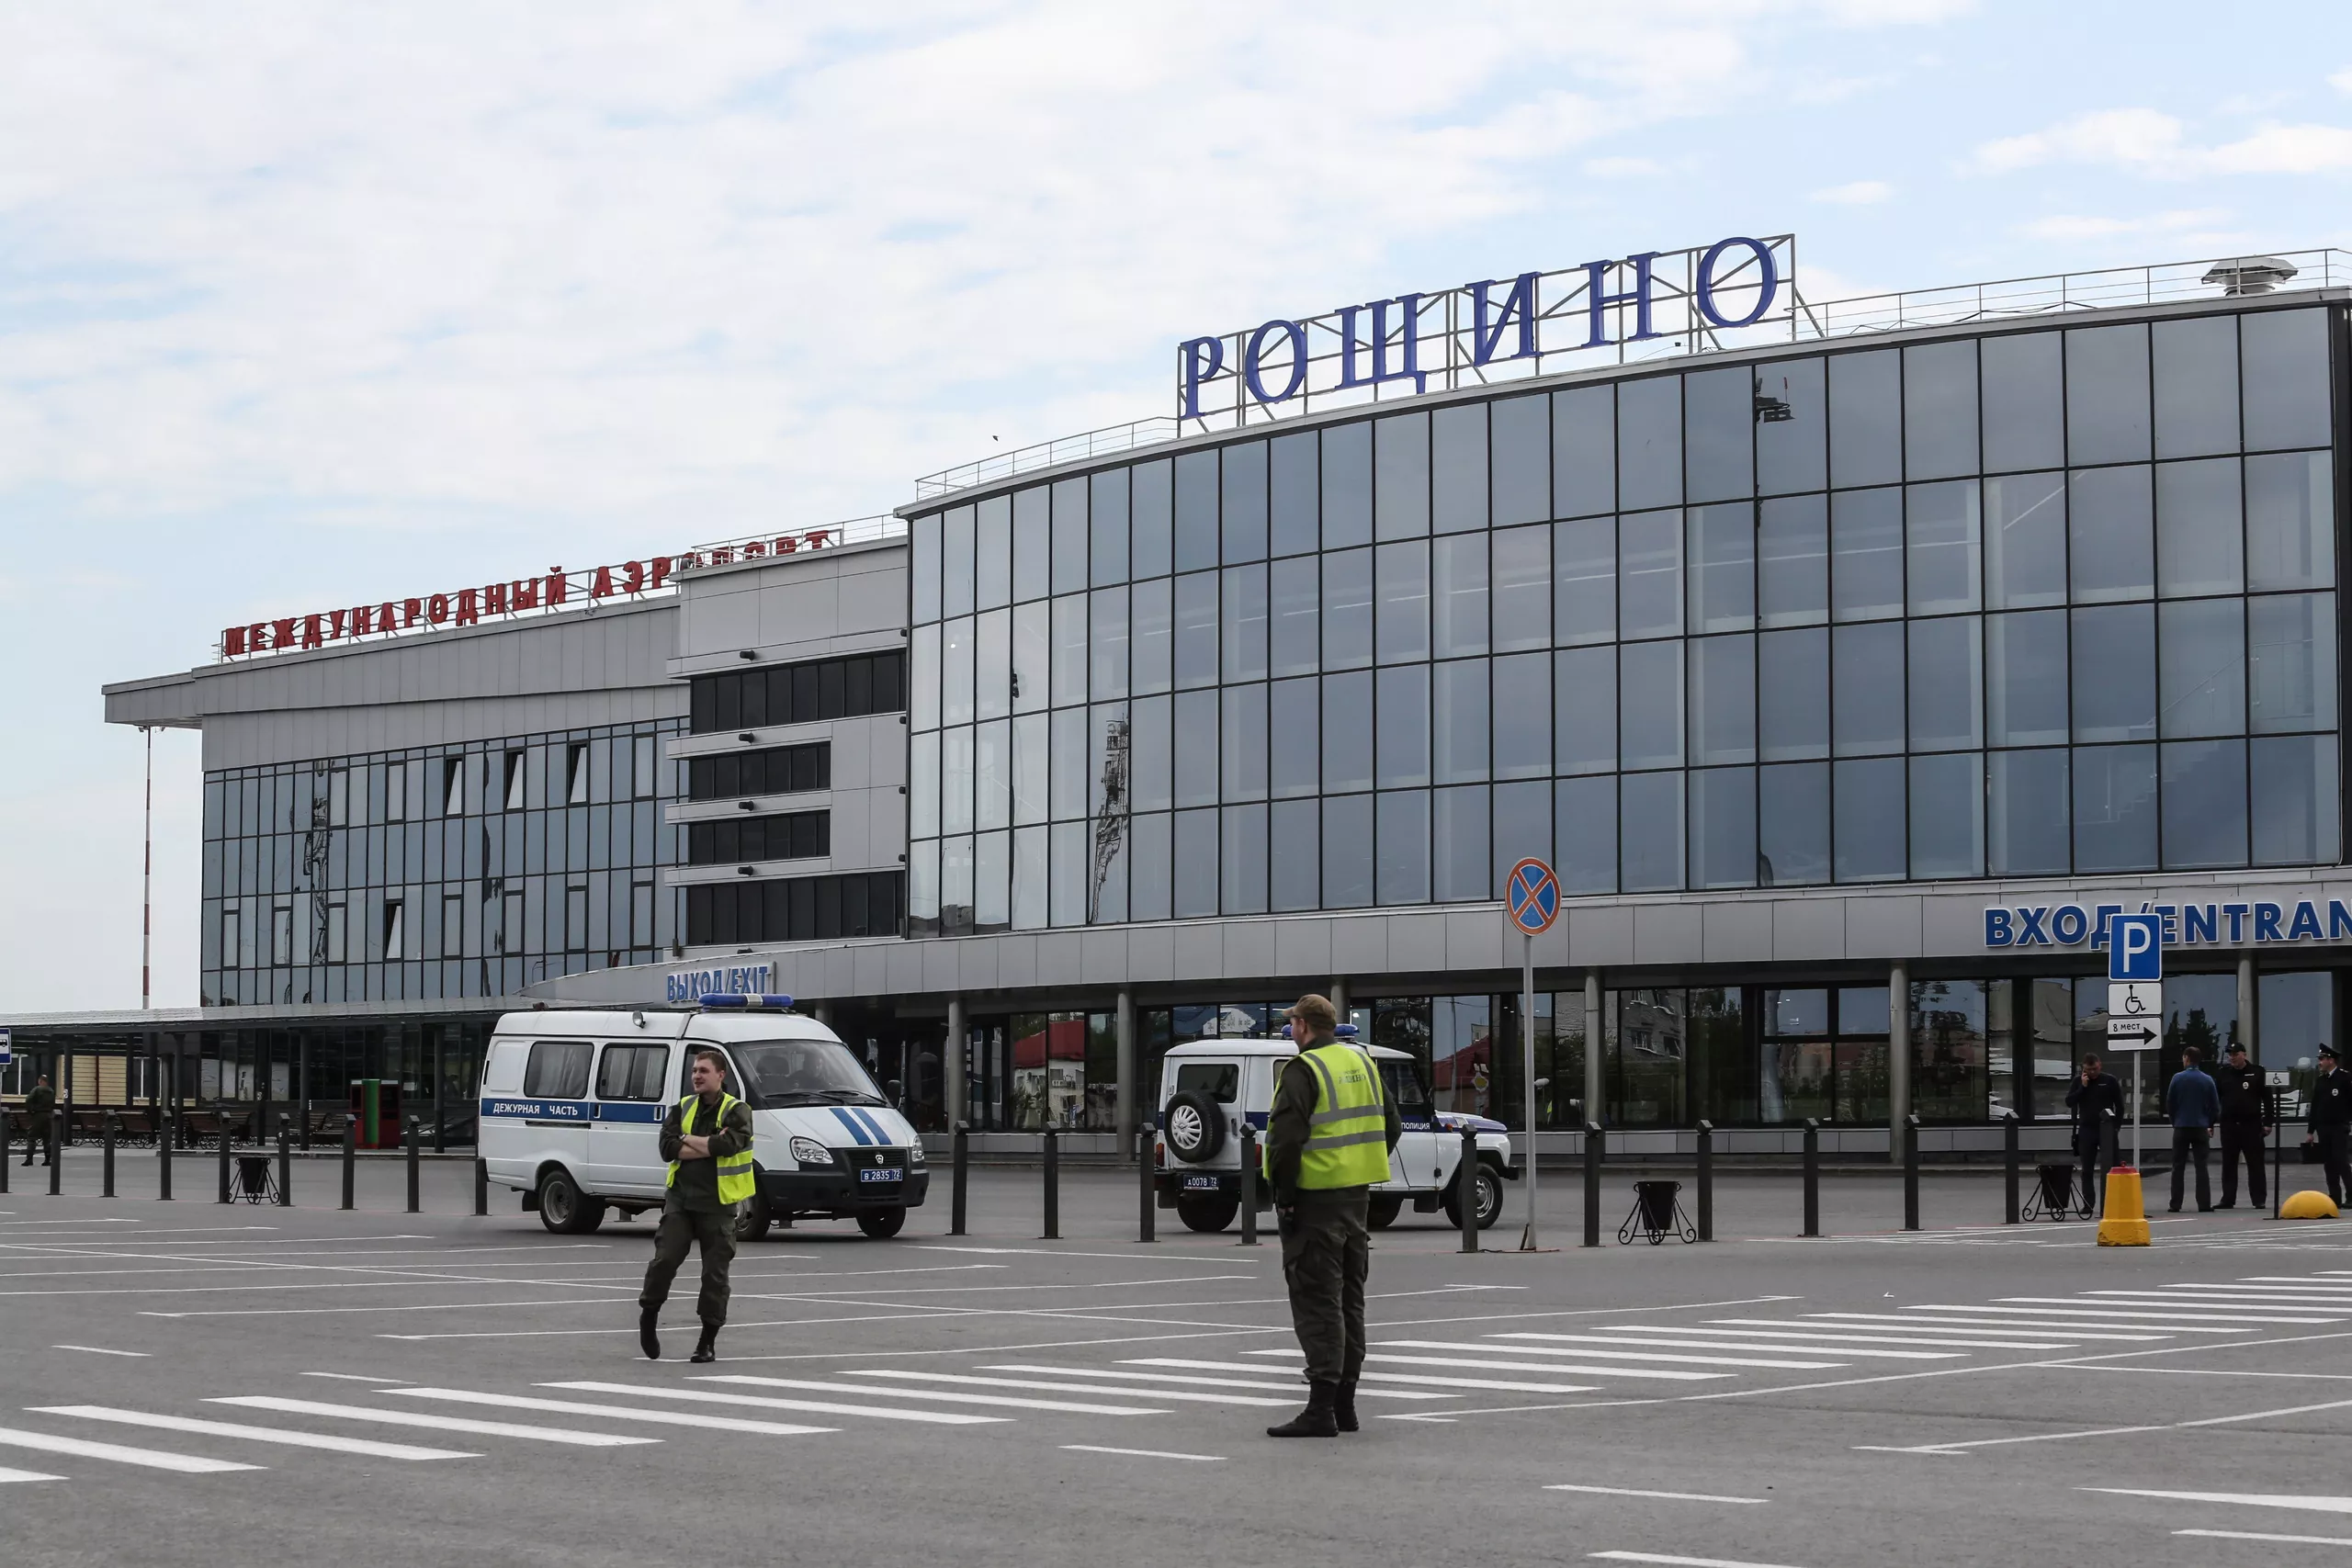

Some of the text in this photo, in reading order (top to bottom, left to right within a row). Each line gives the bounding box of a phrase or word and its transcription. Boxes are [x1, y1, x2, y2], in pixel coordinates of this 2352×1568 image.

[1179, 236, 1778, 420] РОЩИНО
[225, 566, 567, 655] МЕЖДУНАРОДНЫЙ
[2123, 921, 2151, 973] P
[667, 965, 768, 1002] ВЫХОД/EXIT
[2112, 1023, 2119, 1032] 8
[492, 1102, 578, 1116] ДЕЖУРНАЯ ЧАСТЬ
[1401, 1122, 1430, 1131] ПОЛИЦИЯ
[871, 1171, 889, 1179] 2835
